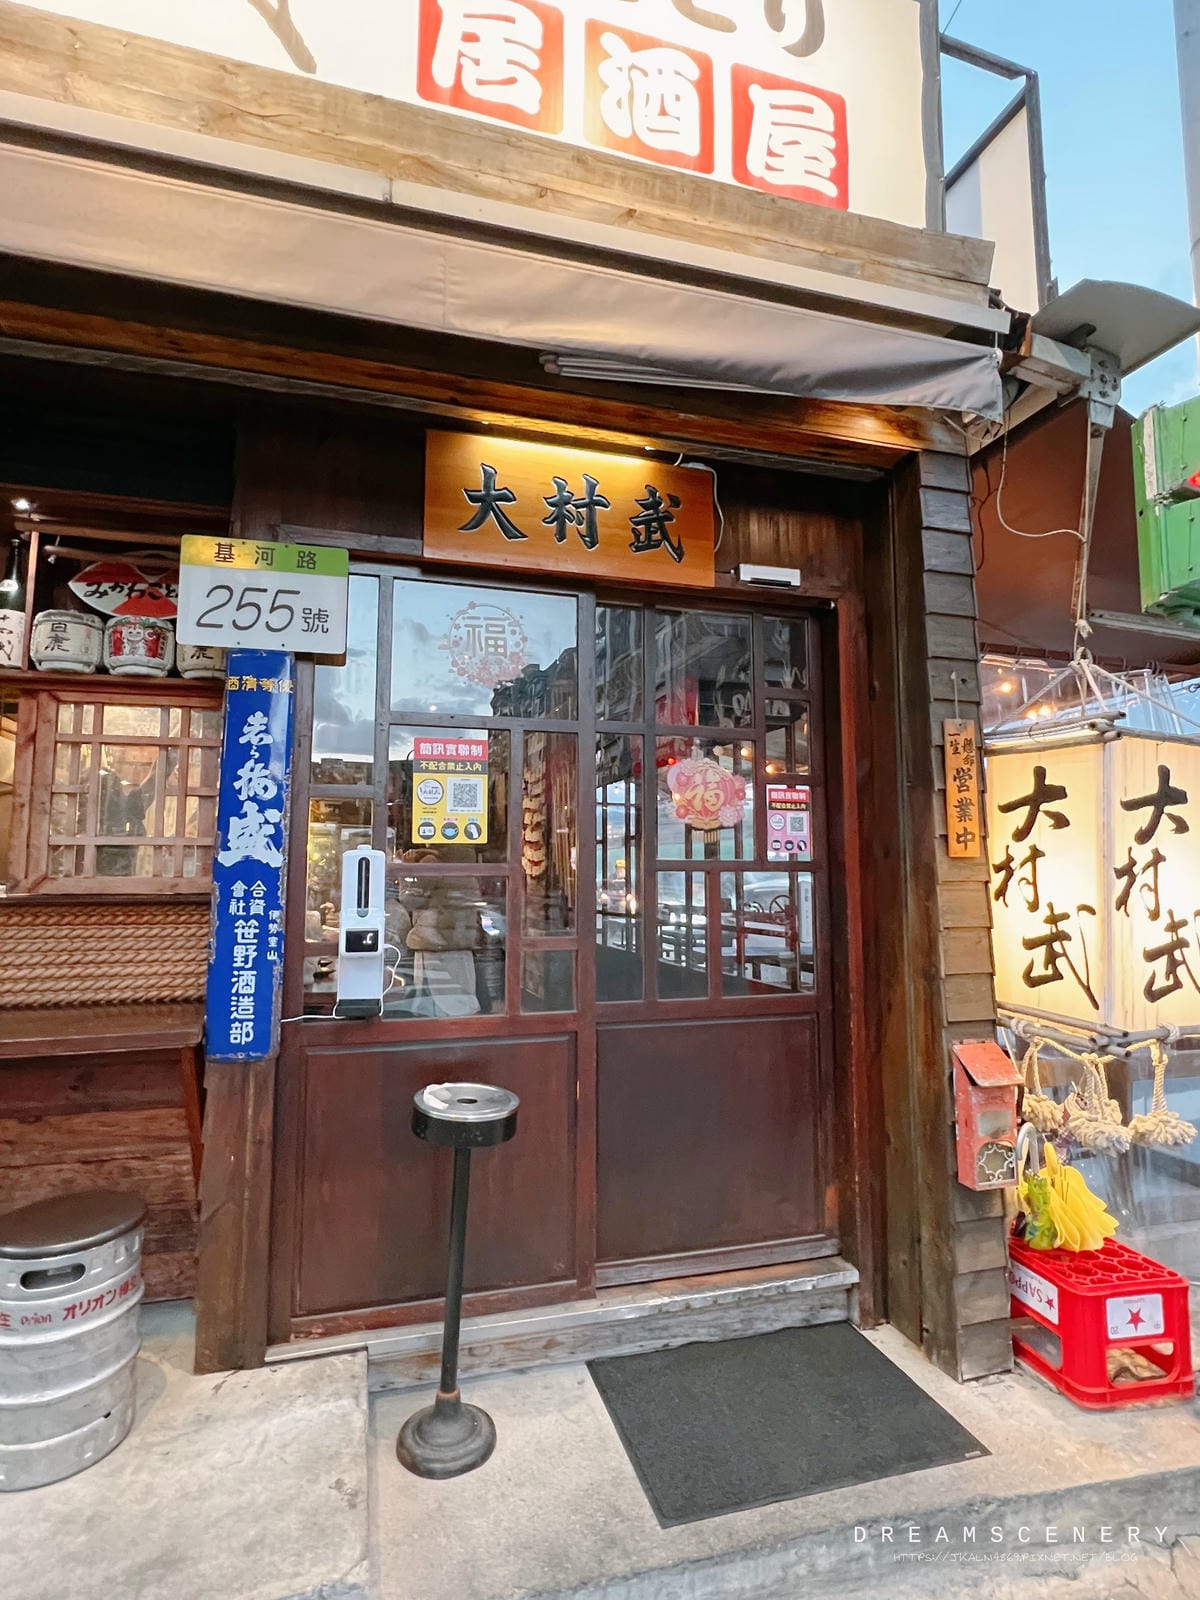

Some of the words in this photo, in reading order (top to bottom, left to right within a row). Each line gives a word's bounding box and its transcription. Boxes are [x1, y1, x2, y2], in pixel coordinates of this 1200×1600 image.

[431, 0, 838, 198] 居酒屋
[214, 542, 317, 570] 基河路
[458, 462, 685, 564] 大村武
[464, 616, 509, 659] 福
[420, 742, 483, 757] 簡訊實聯制
[992, 765, 1099, 1010] 大村武
[229, 918, 259, 1046] 笹野酒造部
